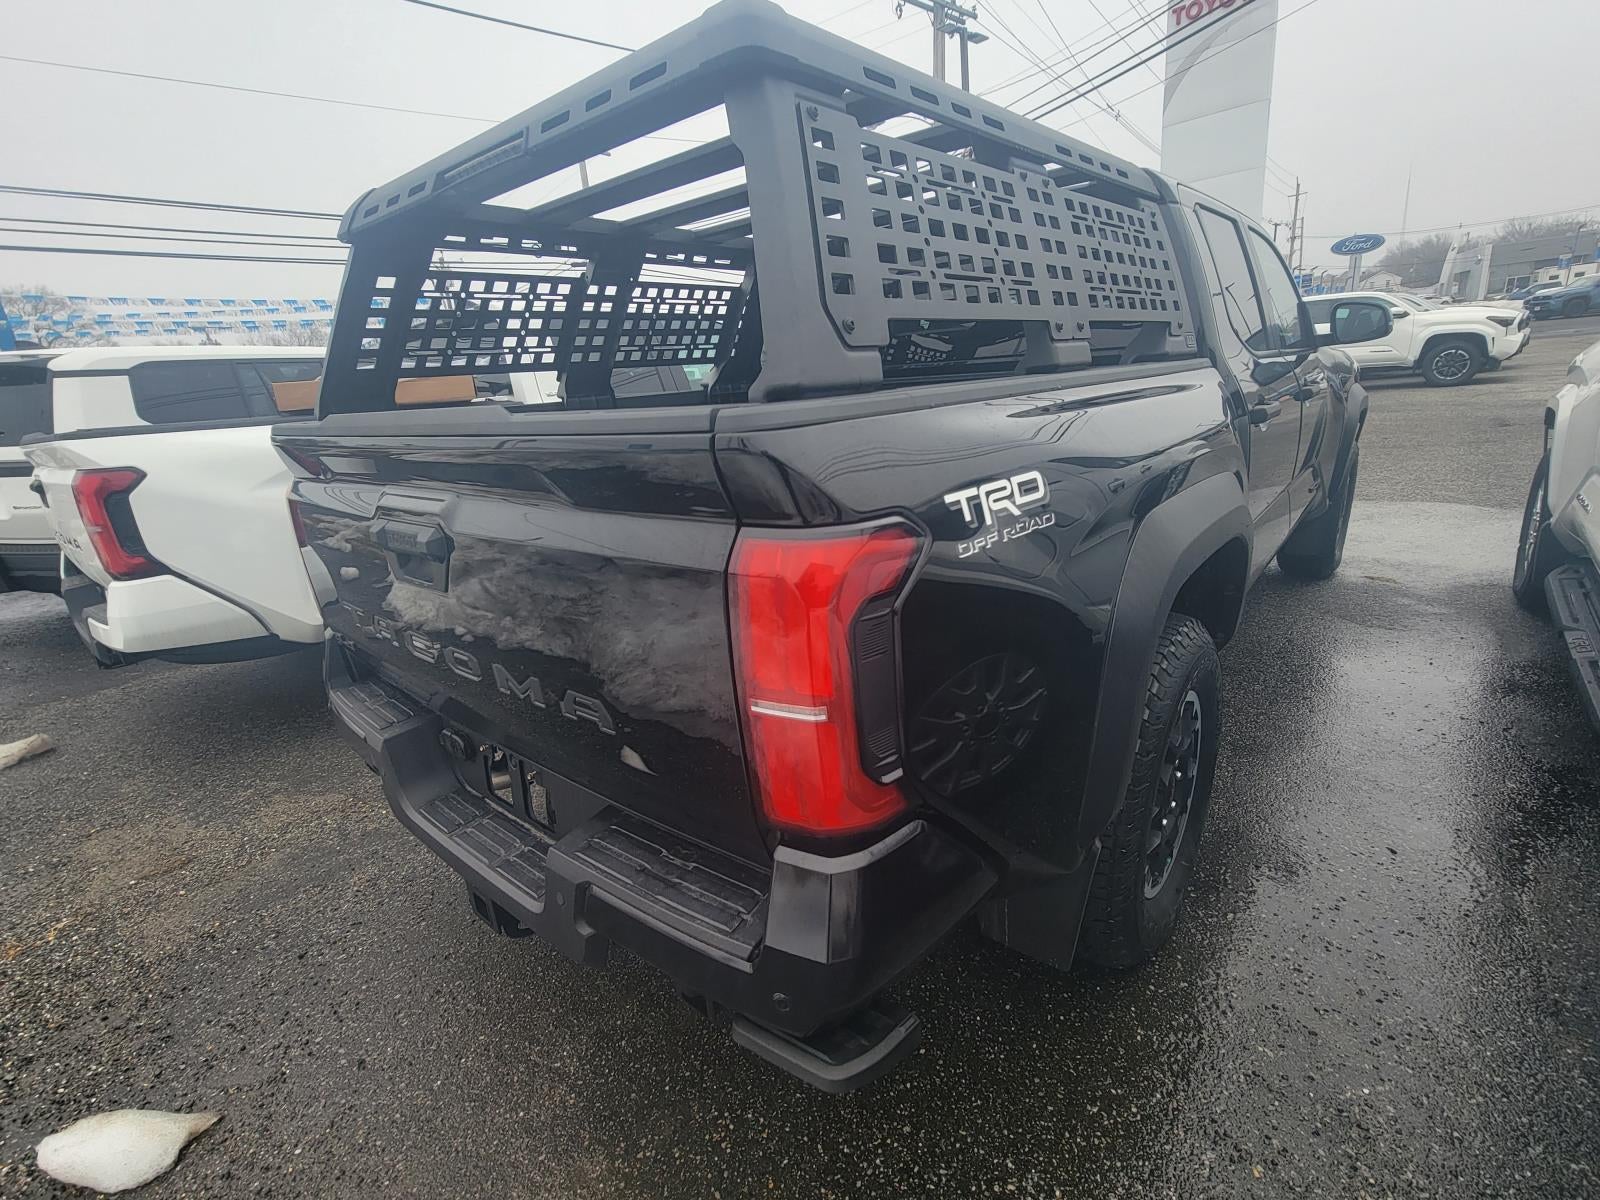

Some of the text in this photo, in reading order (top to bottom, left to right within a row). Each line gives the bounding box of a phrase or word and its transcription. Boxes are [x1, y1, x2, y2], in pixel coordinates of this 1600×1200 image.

[1342, 238, 1374, 251] Ford
[943, 470, 1047, 527] TRD
[957, 513, 1056, 558] OFF ROAD
